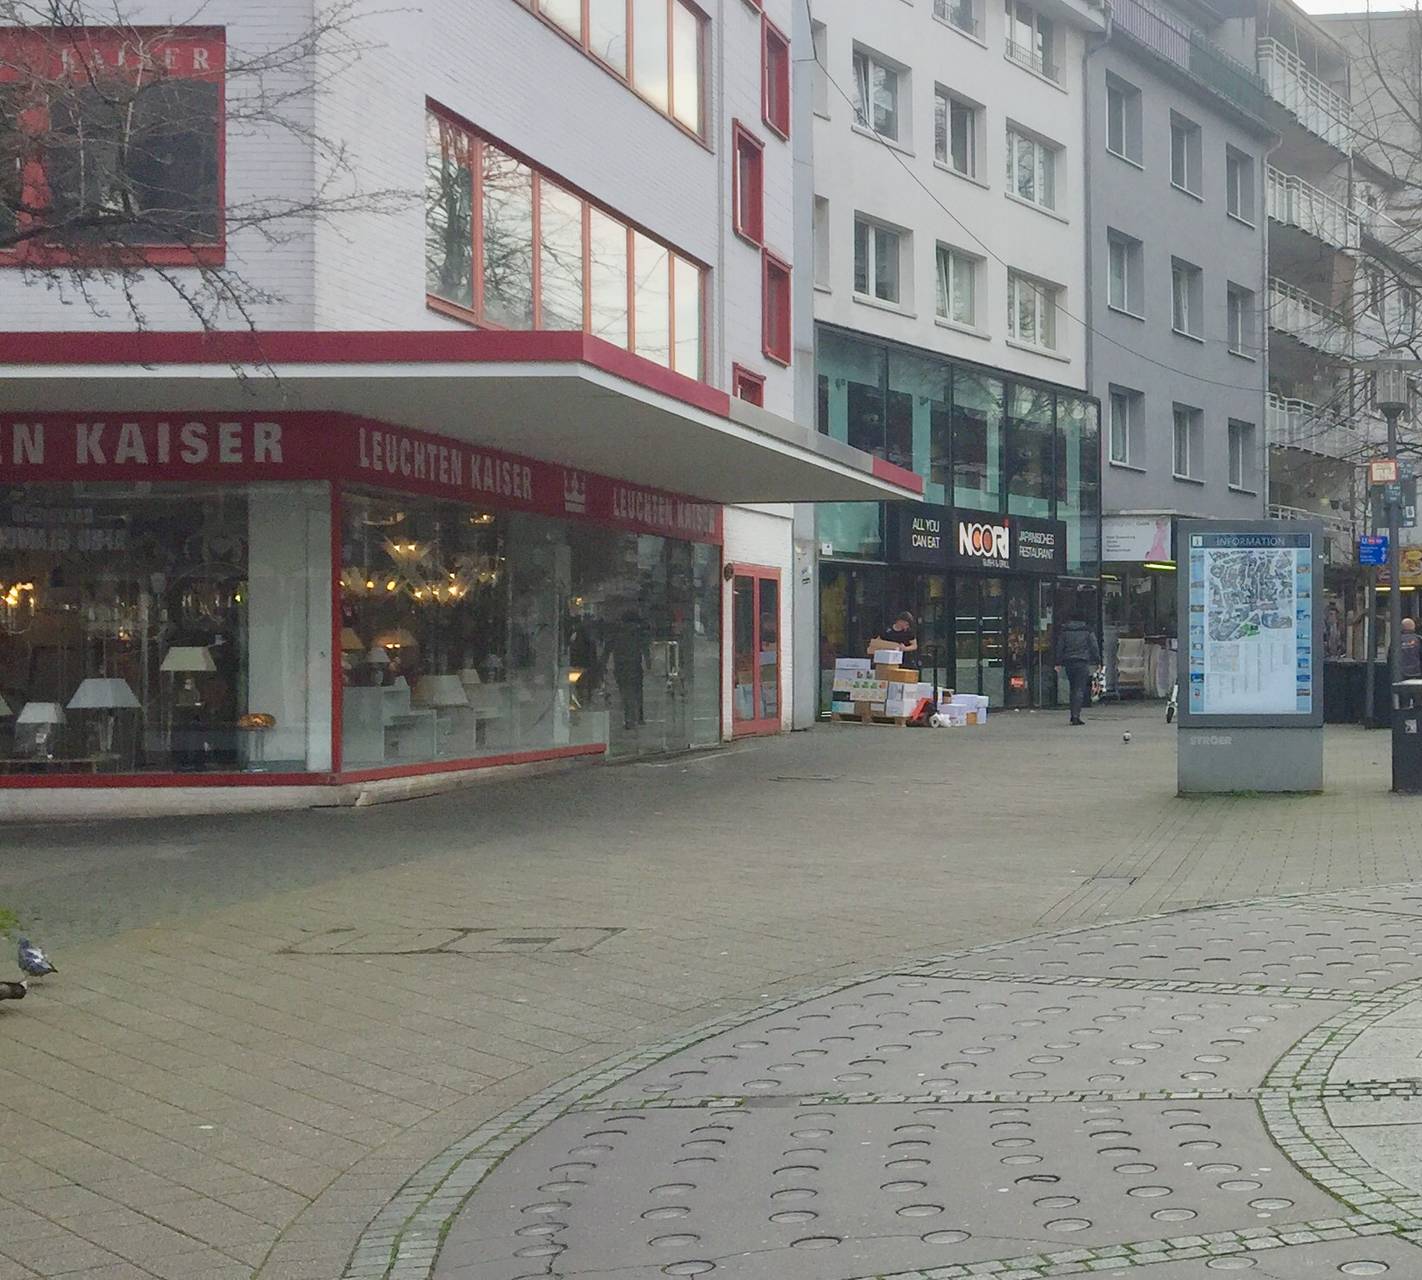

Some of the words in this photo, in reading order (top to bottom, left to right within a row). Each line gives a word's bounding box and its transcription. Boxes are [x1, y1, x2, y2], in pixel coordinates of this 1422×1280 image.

[61, 48, 210, 70] KAIER
[0, 422, 45, 465] N
[75, 421, 284, 465] KAISER
[358, 426, 462, 486] LEUCHTEN
[471, 453, 533, 501] KAISER
[912, 518, 926, 531] ALL
[926, 519, 940, 533] YOU
[912, 534, 927, 548] CAN
[927, 535, 941, 549] EAT
[1216, 536, 1285, 547] INFORMATION
[1018, 545, 1056, 560] RESTAURANT
